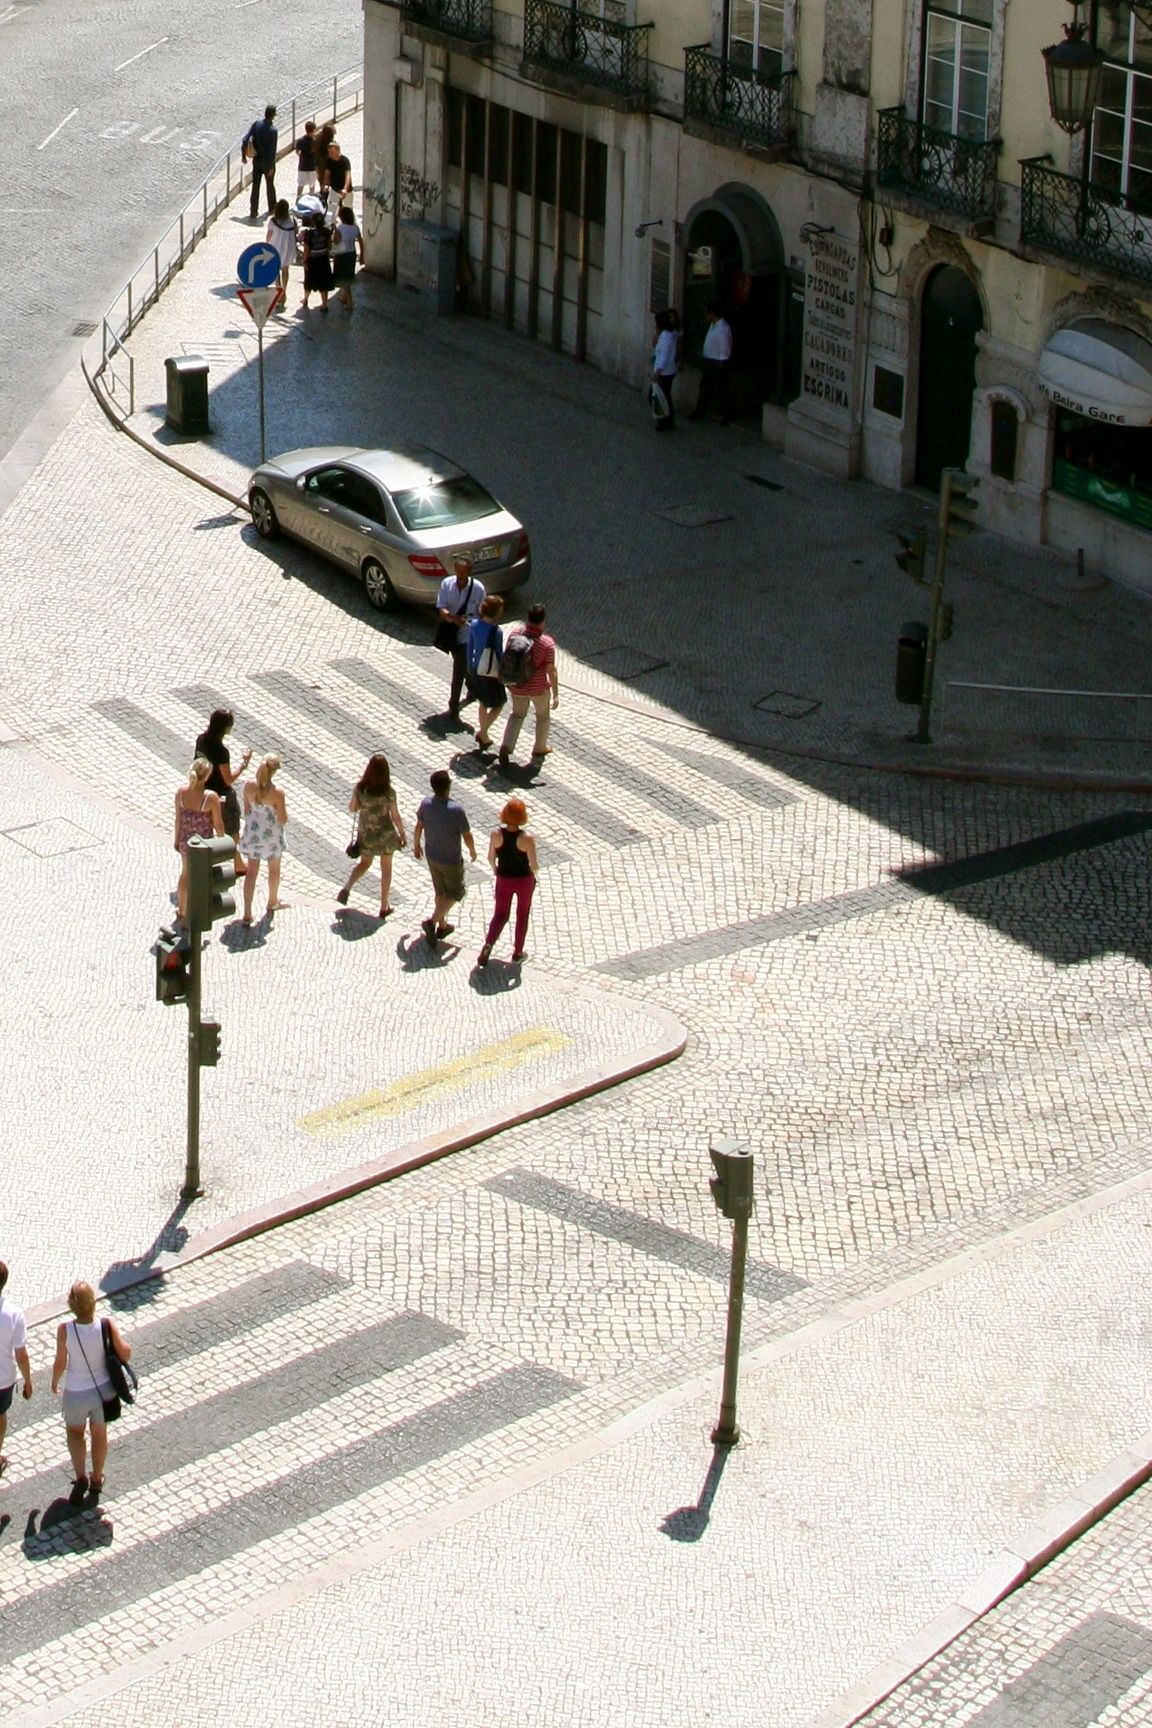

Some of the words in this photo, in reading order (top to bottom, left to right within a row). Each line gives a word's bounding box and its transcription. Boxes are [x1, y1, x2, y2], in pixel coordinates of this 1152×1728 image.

[98, 121, 222, 150] BUS
[807, 274, 855, 305] PISTOLAS
[815, 297, 846, 319] CARGAS
[809, 357, 846, 382] ARTIGOS
[803, 374, 849, 409] ESCRIMA
[1052, 390, 1084, 412] Beira
